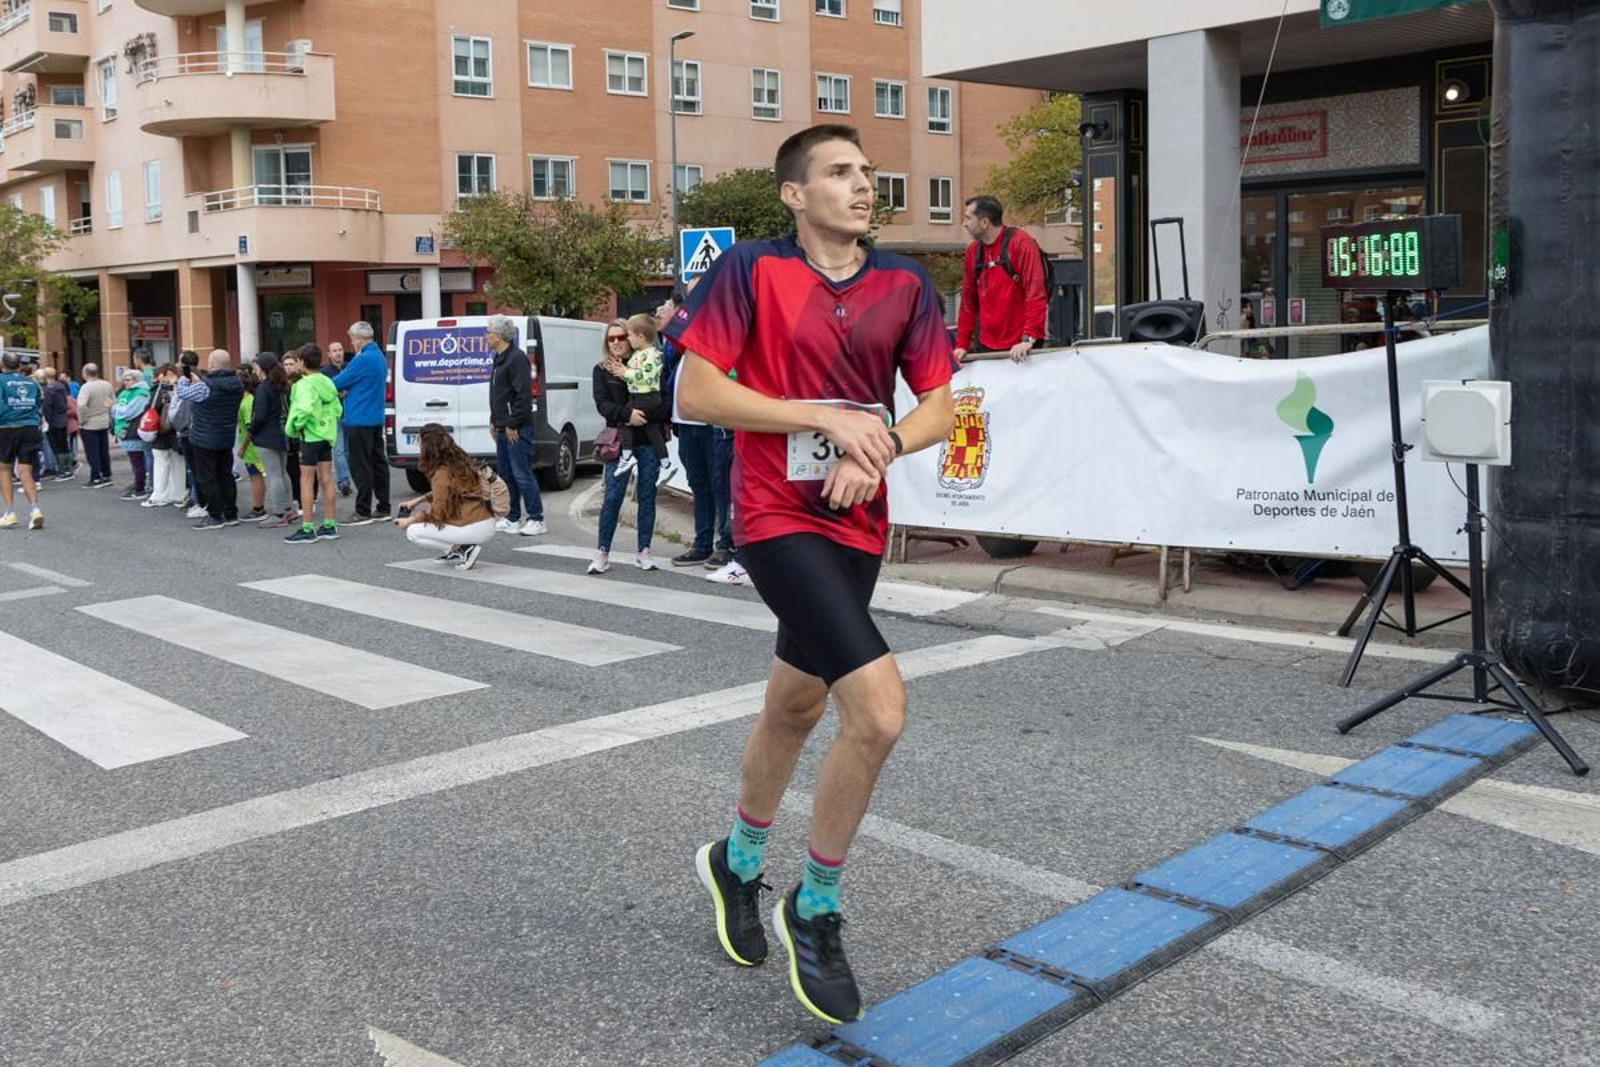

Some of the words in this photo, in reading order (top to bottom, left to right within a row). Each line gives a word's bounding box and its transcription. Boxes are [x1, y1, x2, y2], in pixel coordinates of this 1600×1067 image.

[1236, 488, 1300, 501] Patronato
[1303, 489, 1373, 504] Municipal
[1376, 491, 1395, 502] de
[1253, 503, 1316, 519] Deportes
[1320, 505, 1338, 517] de
[1341, 505, 1376, 518] Jaén
